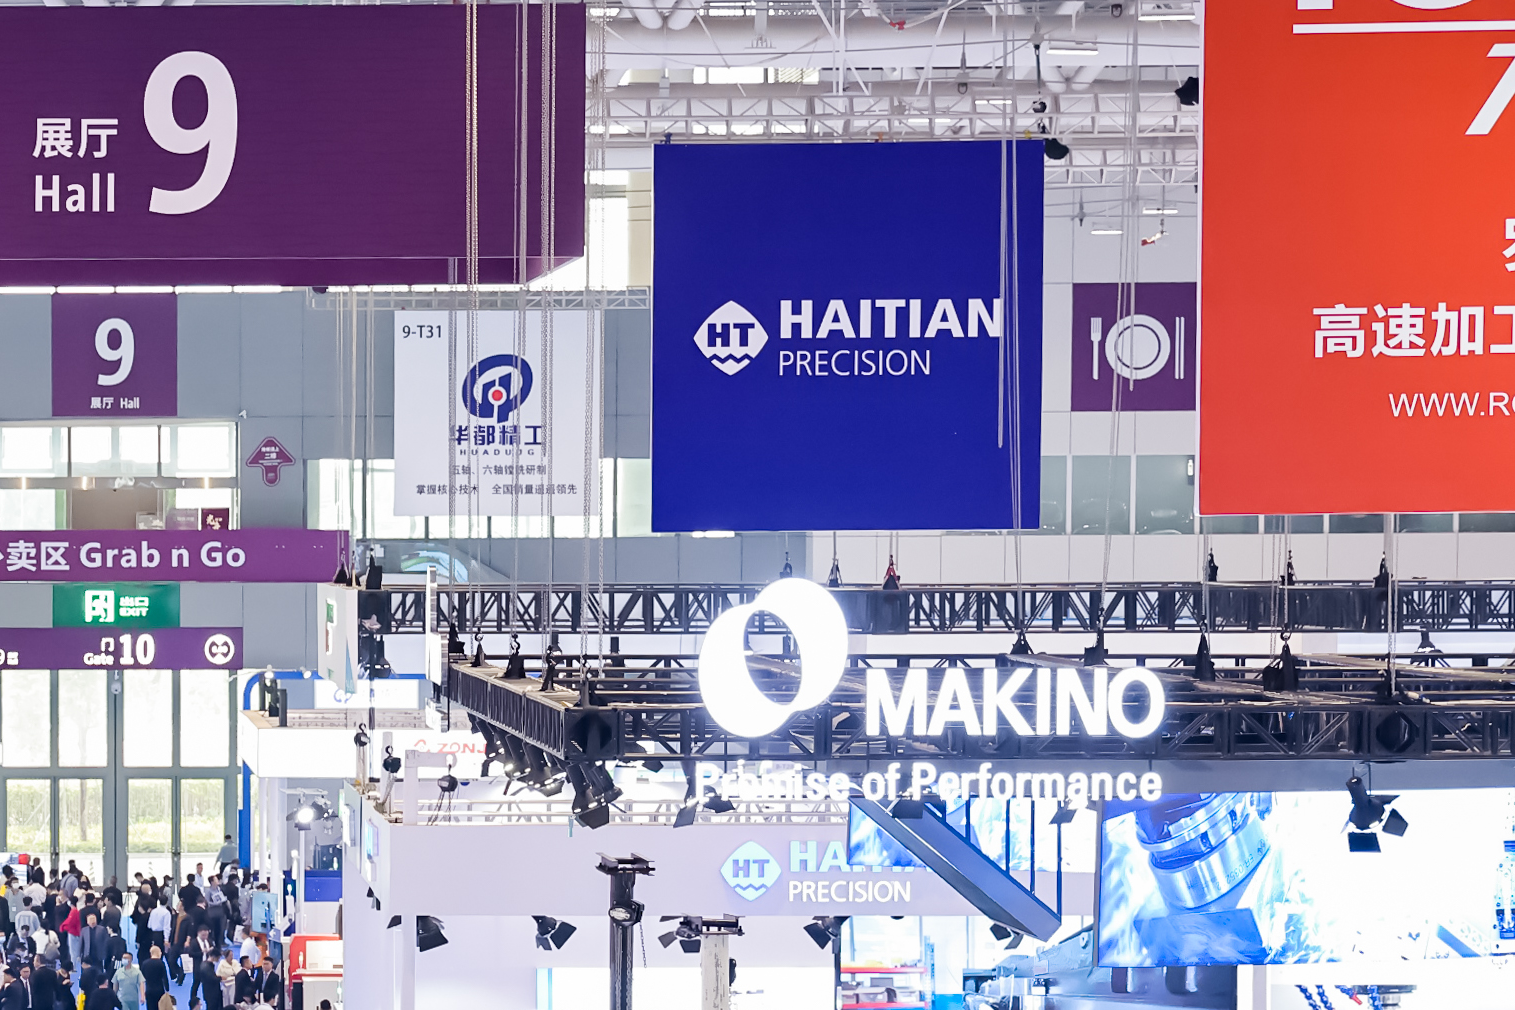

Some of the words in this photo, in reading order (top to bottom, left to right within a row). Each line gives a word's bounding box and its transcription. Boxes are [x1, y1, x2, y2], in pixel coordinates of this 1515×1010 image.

[32, 117, 119, 160] 展厅
[143, 50, 239, 215] 9
[33, 175, 115, 213] Hall
[402, 325, 442, 339] 9-T31
[779, 298, 1002, 340] HAITIAN
[708, 323, 757, 349] HT
[94, 318, 135, 387] 9
[779, 350, 931, 376] PRECISION
[90, 397, 114, 410] 展厅
[120, 397, 140, 410] Hall
[1389, 391, 1515, 417] WWW.R
[416, 484, 479, 495] 掌握核心技术
[80, 542, 160, 568] Grab
[172, 547, 189, 568] n
[200, 542, 246, 568] Go
[119, 597, 149, 607] 出口
[119, 607, 149, 616] EXIT
[84, 653, 114, 665] Gate
[119, 634, 155, 665] 10
[866, 666, 1165, 738] MAKINO
[695, 759, 851, 801] Promise
[862, 762, 901, 801] of
[912, 761, 1162, 801] Performance
[732, 859, 770, 878] HT
[789, 881, 911, 903] PRECISION
